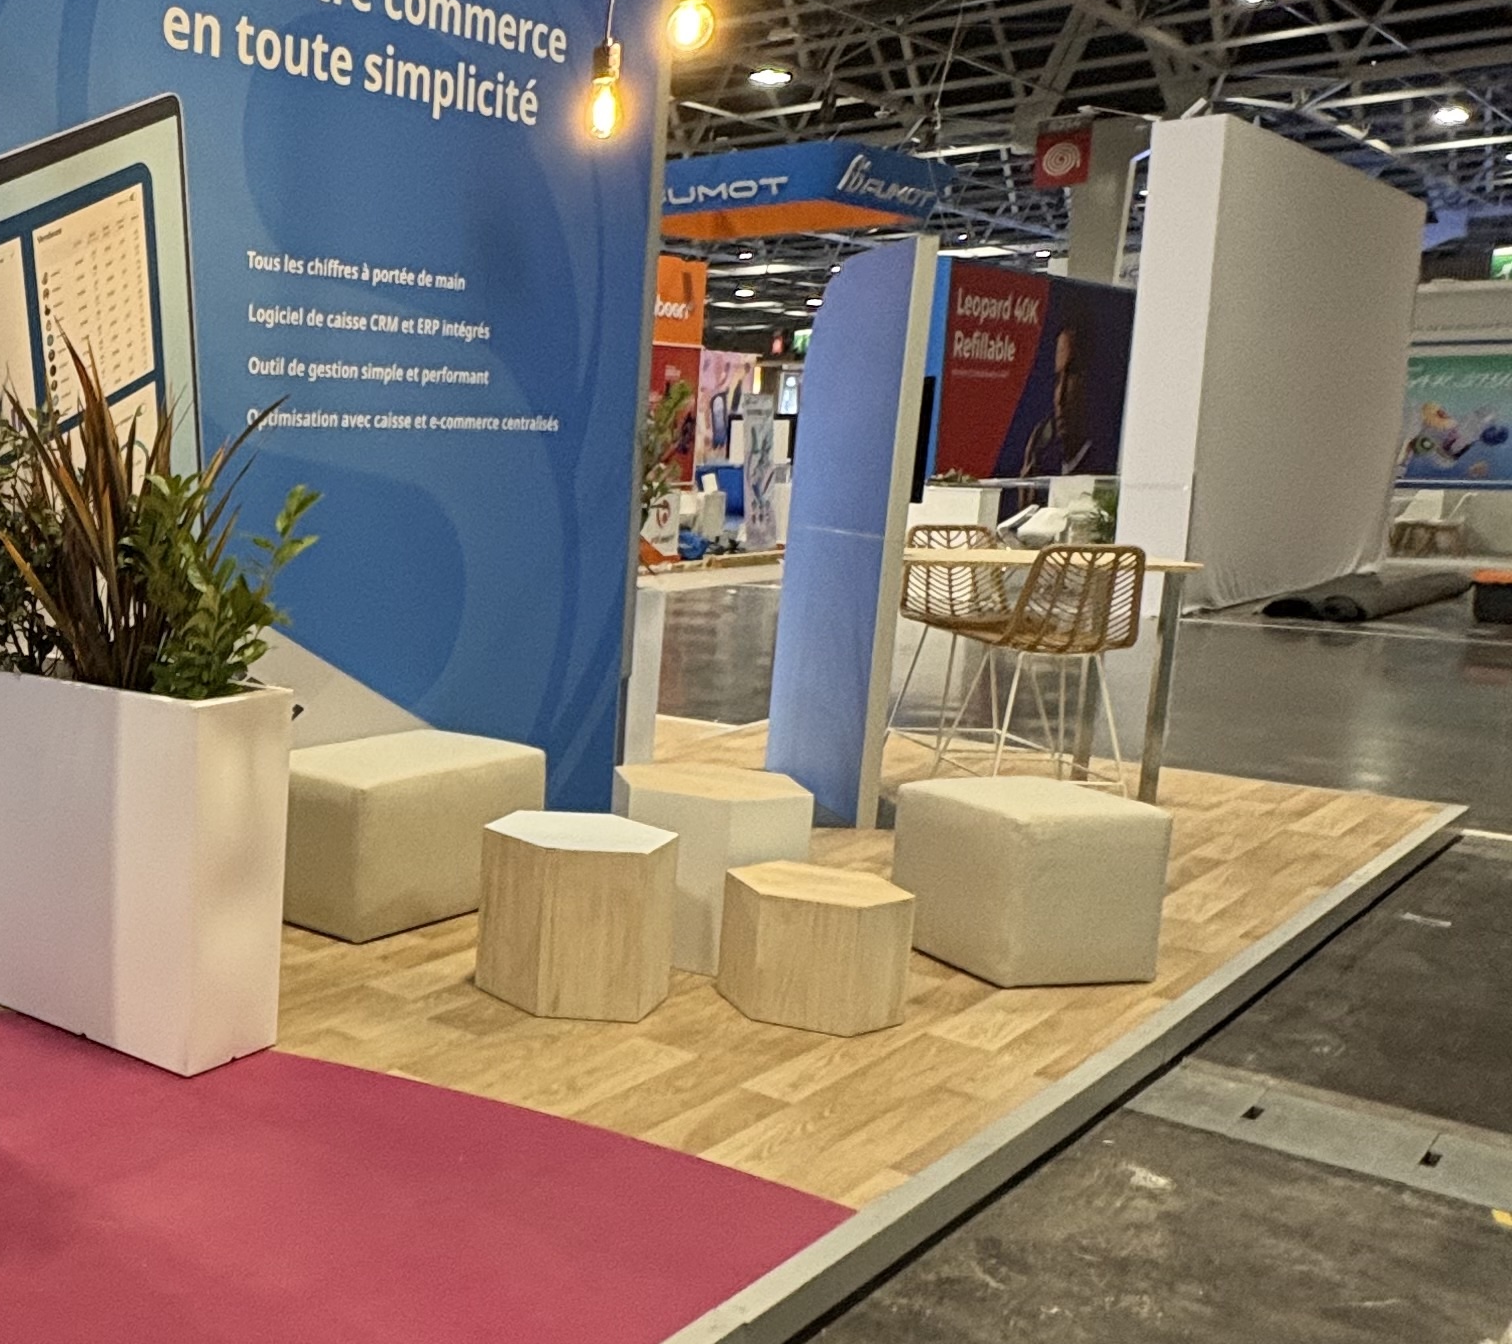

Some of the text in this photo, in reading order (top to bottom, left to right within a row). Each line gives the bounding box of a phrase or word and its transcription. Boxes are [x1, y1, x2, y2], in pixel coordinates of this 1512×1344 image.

[162, 5, 539, 127] en toute simplicité
[662, 176, 788, 205] UMOT
[247, 250, 466, 292] Tous les chiffres à portée de main
[248, 303, 490, 343] Logiciel de caisse CRM et ERP intégrés
[956, 287, 1013, 325] Leopard
[952, 330, 1017, 362] Refillable
[248, 356, 490, 387] Outil de gestion simple et performant
[341, 412, 371, 429] avec
[373, 412, 411, 430] caisse
[414, 413, 427, 430] et
[429, 415, 500, 431] e-commerce
[501, 414, 560, 432] centralisés
